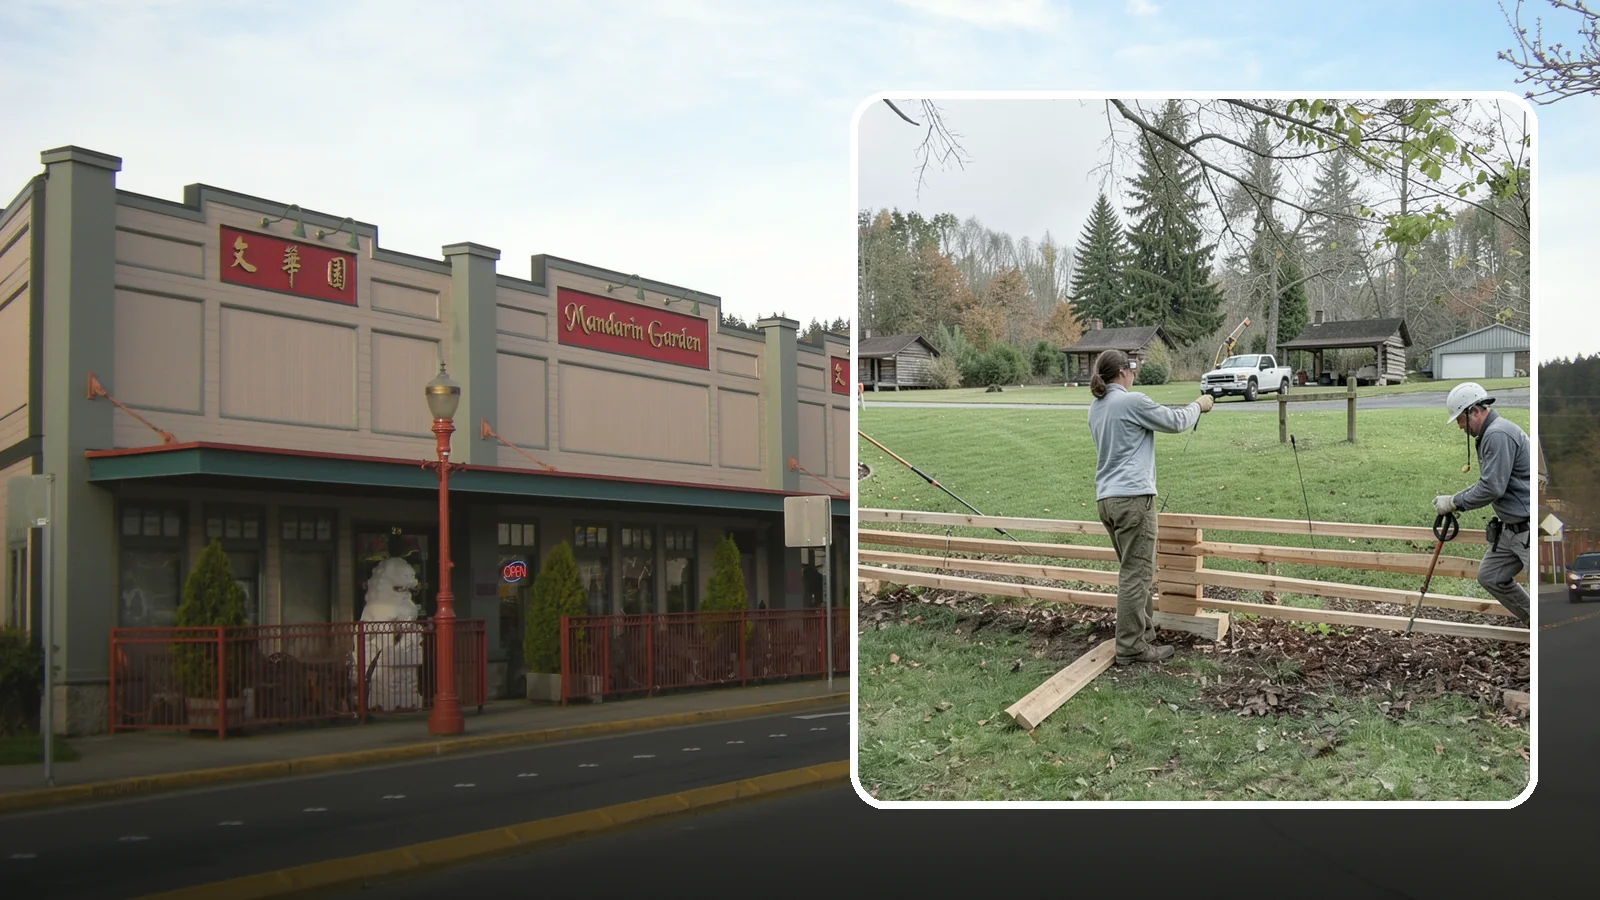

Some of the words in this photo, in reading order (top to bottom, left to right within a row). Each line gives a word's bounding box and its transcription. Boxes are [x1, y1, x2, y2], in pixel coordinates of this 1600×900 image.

[564, 302, 644, 341] Mandarin
[647, 320, 702, 352] Garden
[503, 565, 527, 578] OPEN
